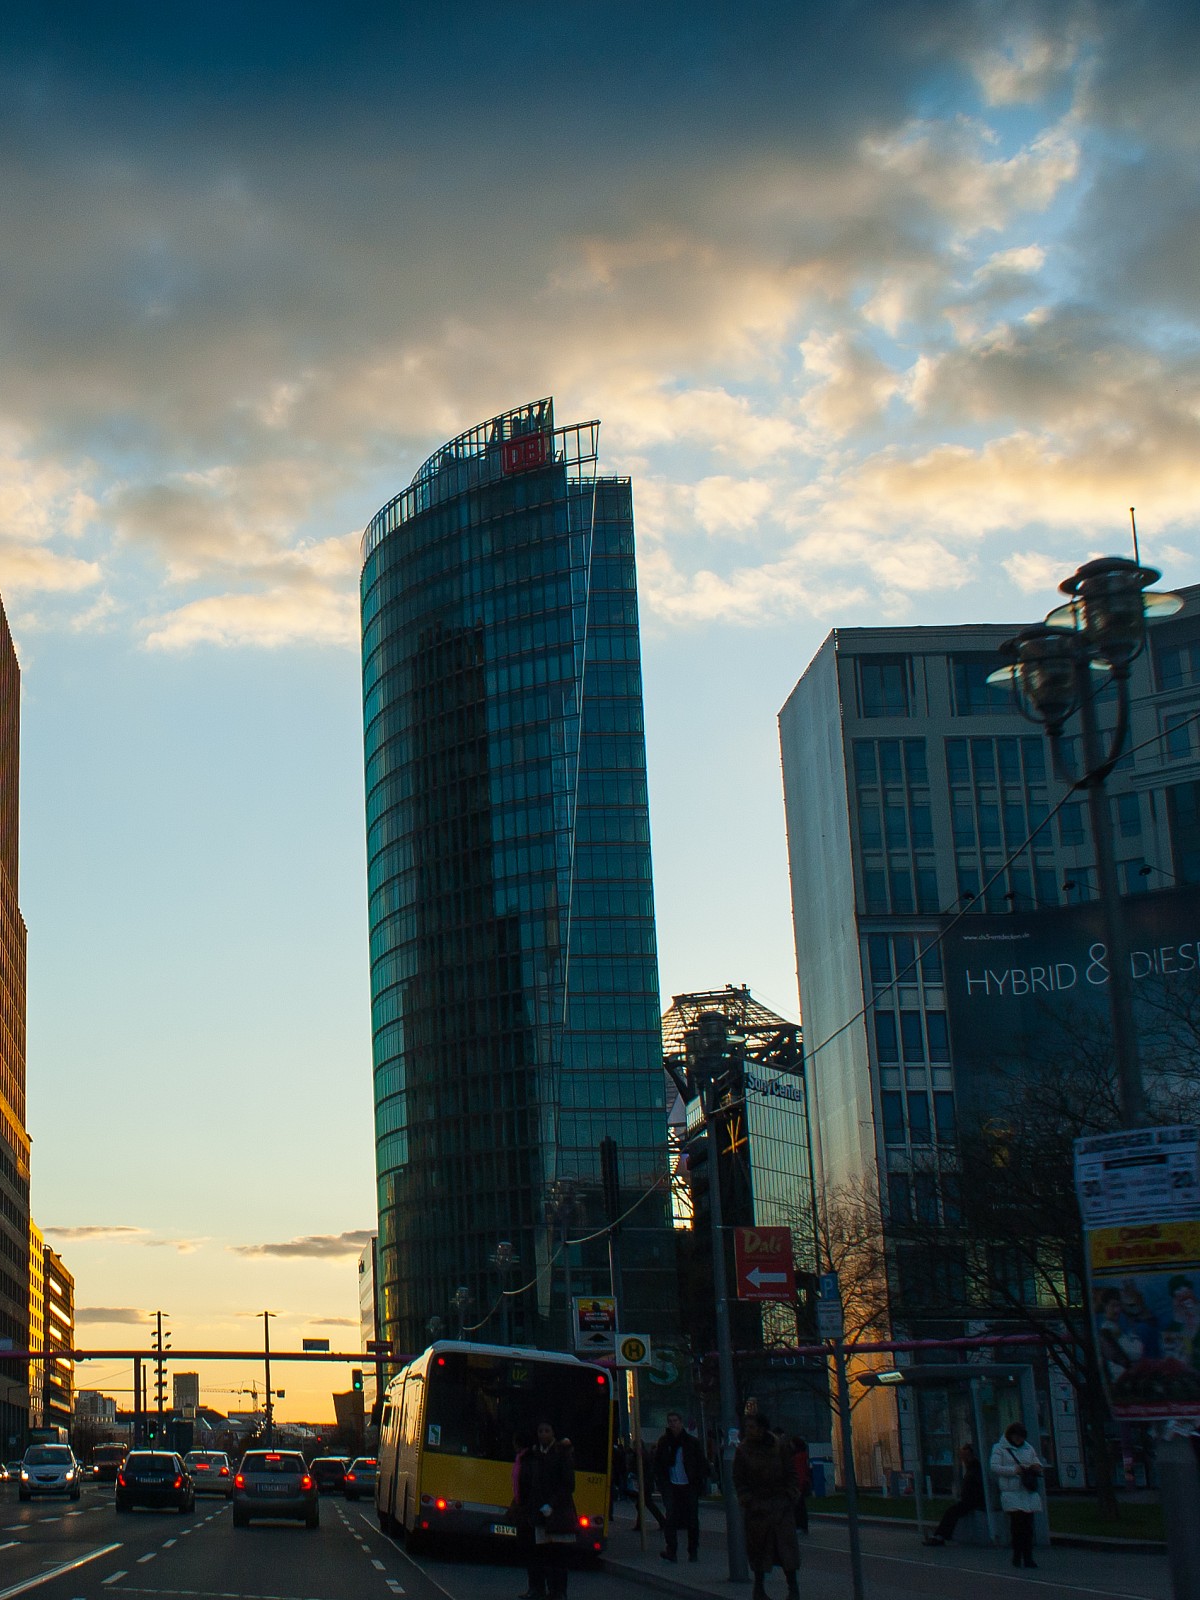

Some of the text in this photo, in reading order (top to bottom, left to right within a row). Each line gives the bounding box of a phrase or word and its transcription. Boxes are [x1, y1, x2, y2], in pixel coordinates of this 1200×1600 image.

[507, 438, 539, 469] DB
[966, 963, 1076, 995] HYBRID
[1086, 943, 1110, 984] &
[748, 1073, 801, 1101] Sony Center
[824, 1278, 833, 1299] P
[629, 1343, 639, 1356] H
